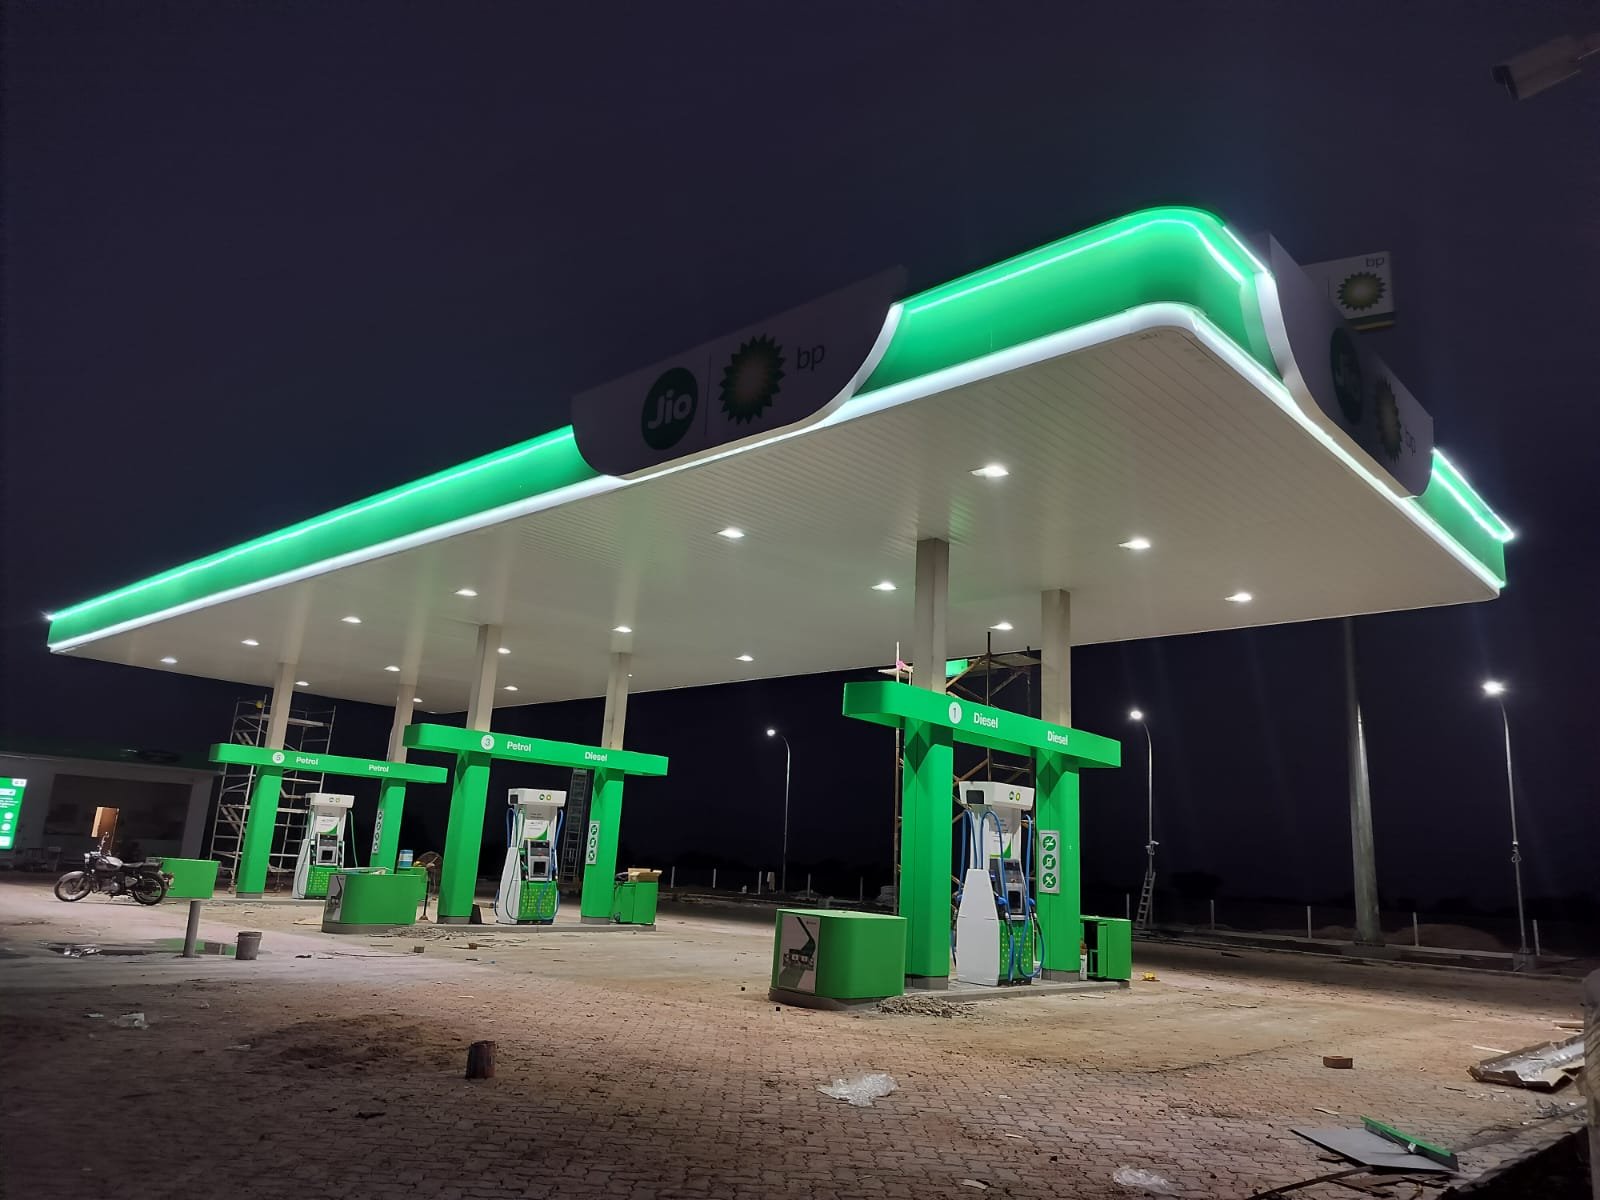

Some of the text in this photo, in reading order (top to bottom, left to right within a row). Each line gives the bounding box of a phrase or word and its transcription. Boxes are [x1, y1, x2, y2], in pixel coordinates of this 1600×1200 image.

[1366, 256, 1385, 269] bp
[647, 345, 825, 429] Jio bp
[973, 712, 999, 729] Diesel
[1047, 730, 1069, 746] Diesel
[507, 741, 532, 752] Petrol
[296, 756, 319, 766] Petrol
[584, 751, 608, 762] Diesel
[368, 764, 389, 773] Petrol
